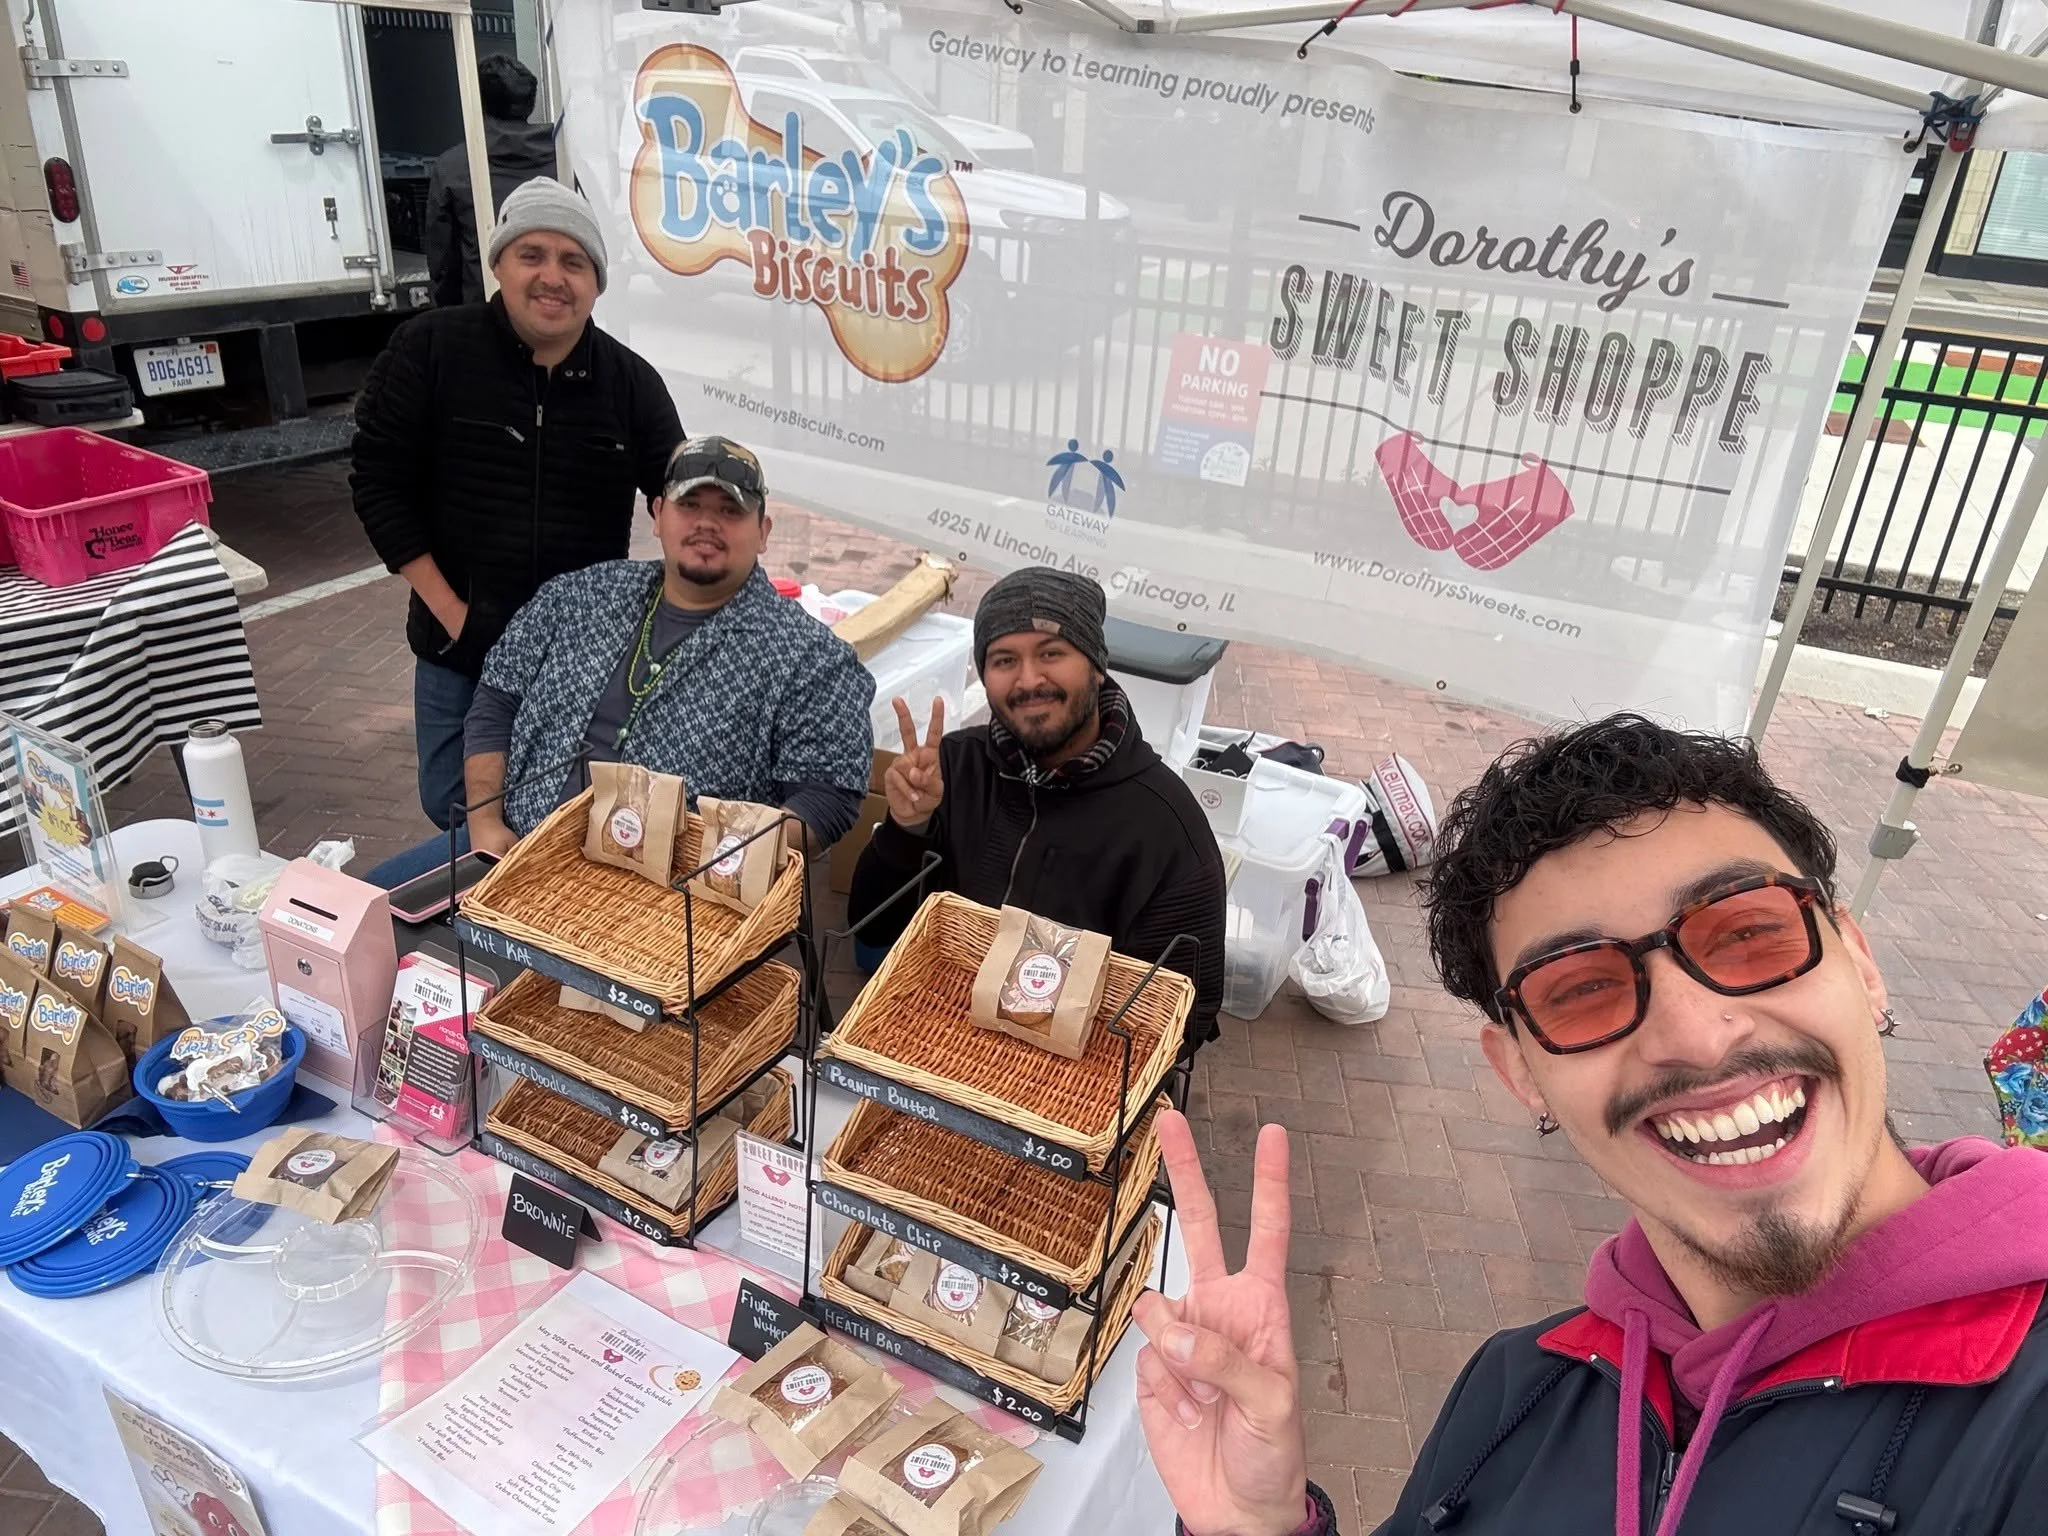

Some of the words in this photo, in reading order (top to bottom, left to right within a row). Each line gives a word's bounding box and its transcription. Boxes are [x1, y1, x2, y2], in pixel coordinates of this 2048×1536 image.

[928, 29, 1036, 73] Gateway
[1041, 43, 1067, 74] to
[1073, 53, 1179, 98] Learning
[1183, 77, 1279, 115] proudly
[1282, 93, 1376, 136] presents
[638, 95, 949, 262] Barley's
[1374, 191, 1695, 312] Dorothy's
[747, 230, 934, 322] Biscuits
[147, 355, 214, 382] BD64691
[1199, 344, 1240, 377] NO
[1269, 264, 1470, 406] SWEET
[1493, 316, 1773, 454] SHOPPE
[173, 378, 192, 388] FARM
[1181, 373, 1249, 399] PARKING
[703, 383, 886, 452] www.BarleysBiscuits.com
[1046, 503, 1111, 535] GATEWAY
[1058, 523, 1107, 549] LEARNING
[927, 507, 970, 536] 4925
[974, 522, 991, 544] N
[994, 527, 1058, 567] Lincoln
[1110, 570, 1211, 613] Chicago,
[1218, 592, 1236, 612] IL
[1312, 549, 1582, 640] www.DorothysSweets.com
[288, 916, 319, 933] DONATIONS
[470, 926, 497, 953] Kit
[61, 951, 98, 971] Barley's
[115, 975, 150, 996] Barley's
[607, 984, 656, 1016] $2.00
[38, 1004, 78, 1026] Barley's
[618, 1106, 661, 1136] $2.00
[742, 1140, 772, 1162] SWEET
[775, 1152, 805, 1174] SHOPP
[1022, 1137, 1072, 1170] $2.00
[743, 1185, 760, 1195] FOOD
[761, 1192, 787, 1206] ALLERGY
[788, 1202, 807, 1213] NOTIC
[512, 1192, 576, 1240] BROWNIE
[623, 1207, 663, 1240] $2.00
[822, 1190, 897, 1235] Chocolate
[906, 1223, 942, 1252] Chip
[998, 1263, 1049, 1297] $2.00
[741, 1289, 780, 1321] Fluffer
[824, 1309, 870, 1340] HEATH
[876, 1330, 904, 1357] BAR
[538, 1326, 551, 1336] May
[552, 1334, 567, 1345] 2026
[568, 1344, 590, 1359] Cookies
[591, 1359, 605, 1367] and
[604, 1364, 626, 1379] Baked
[624, 1377, 643, 1390] Goods
[644, 1388, 672, 1406] Schedule
[991, 1386, 1043, 1422] $2.00
